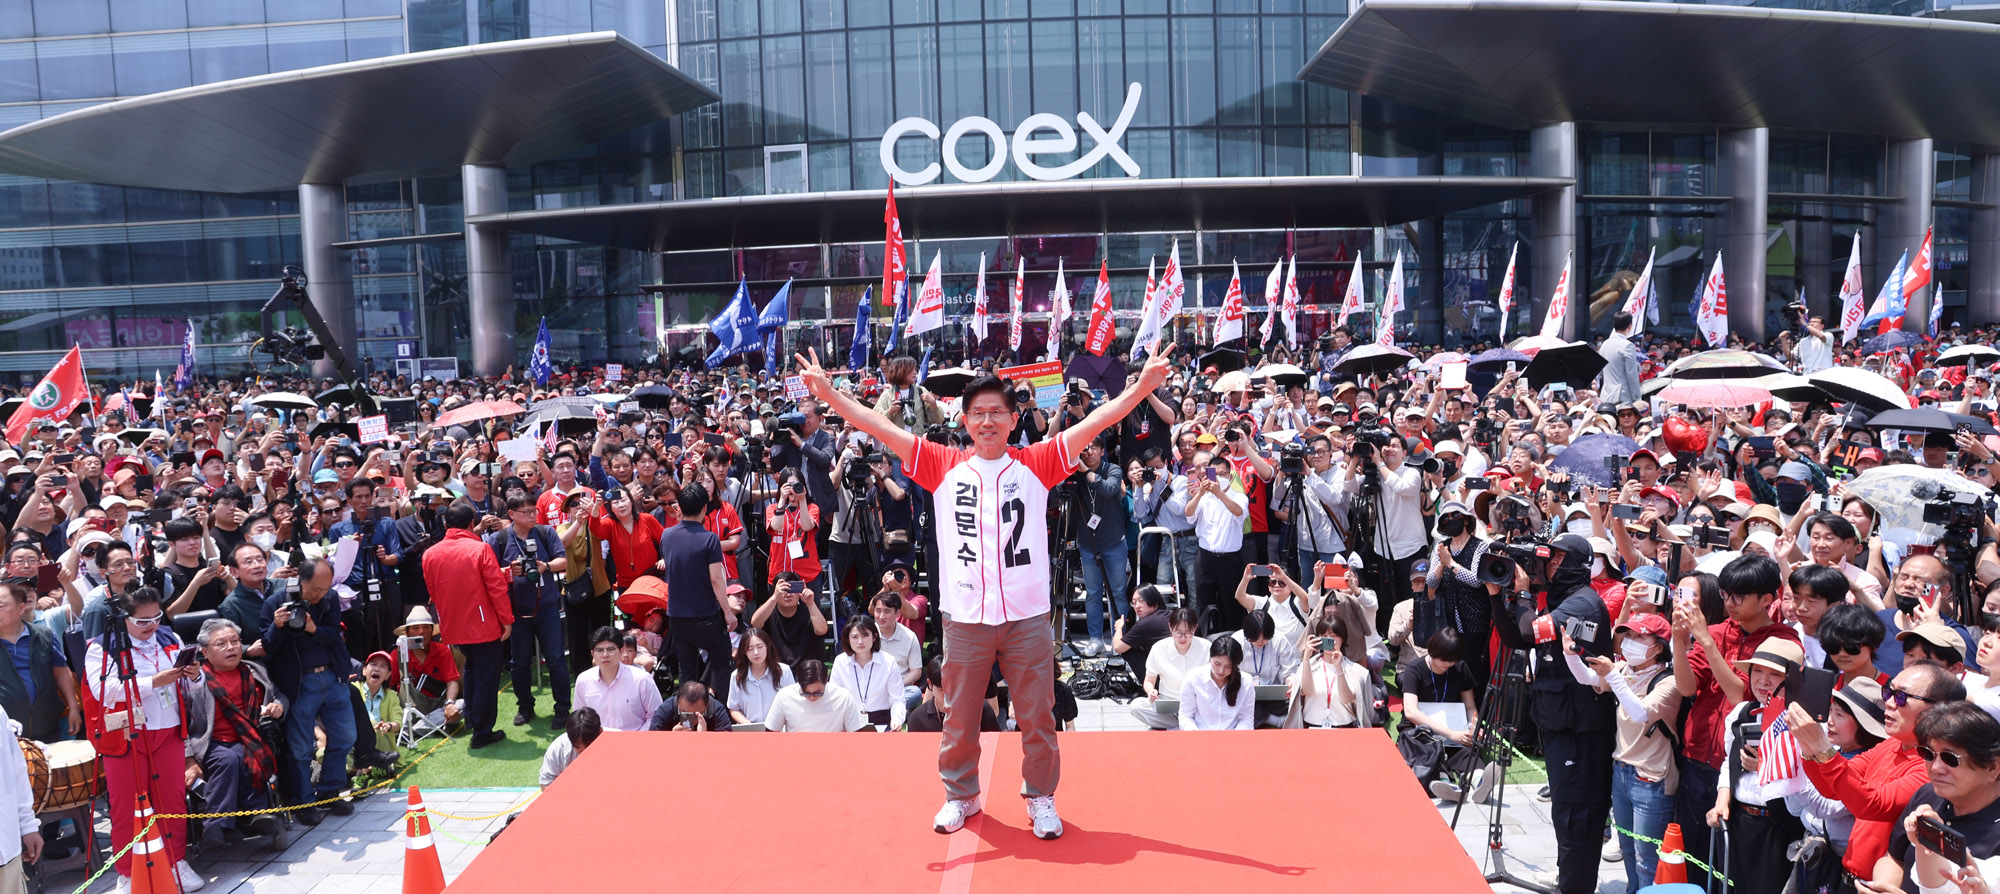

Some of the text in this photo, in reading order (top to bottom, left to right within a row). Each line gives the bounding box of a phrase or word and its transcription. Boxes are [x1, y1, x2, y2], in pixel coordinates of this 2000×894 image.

[880, 82, 1142, 186] coex
[965, 293, 990, 304] Gae
[955, 482, 978, 567] 김문수
[1001, 497, 1032, 569] 2
